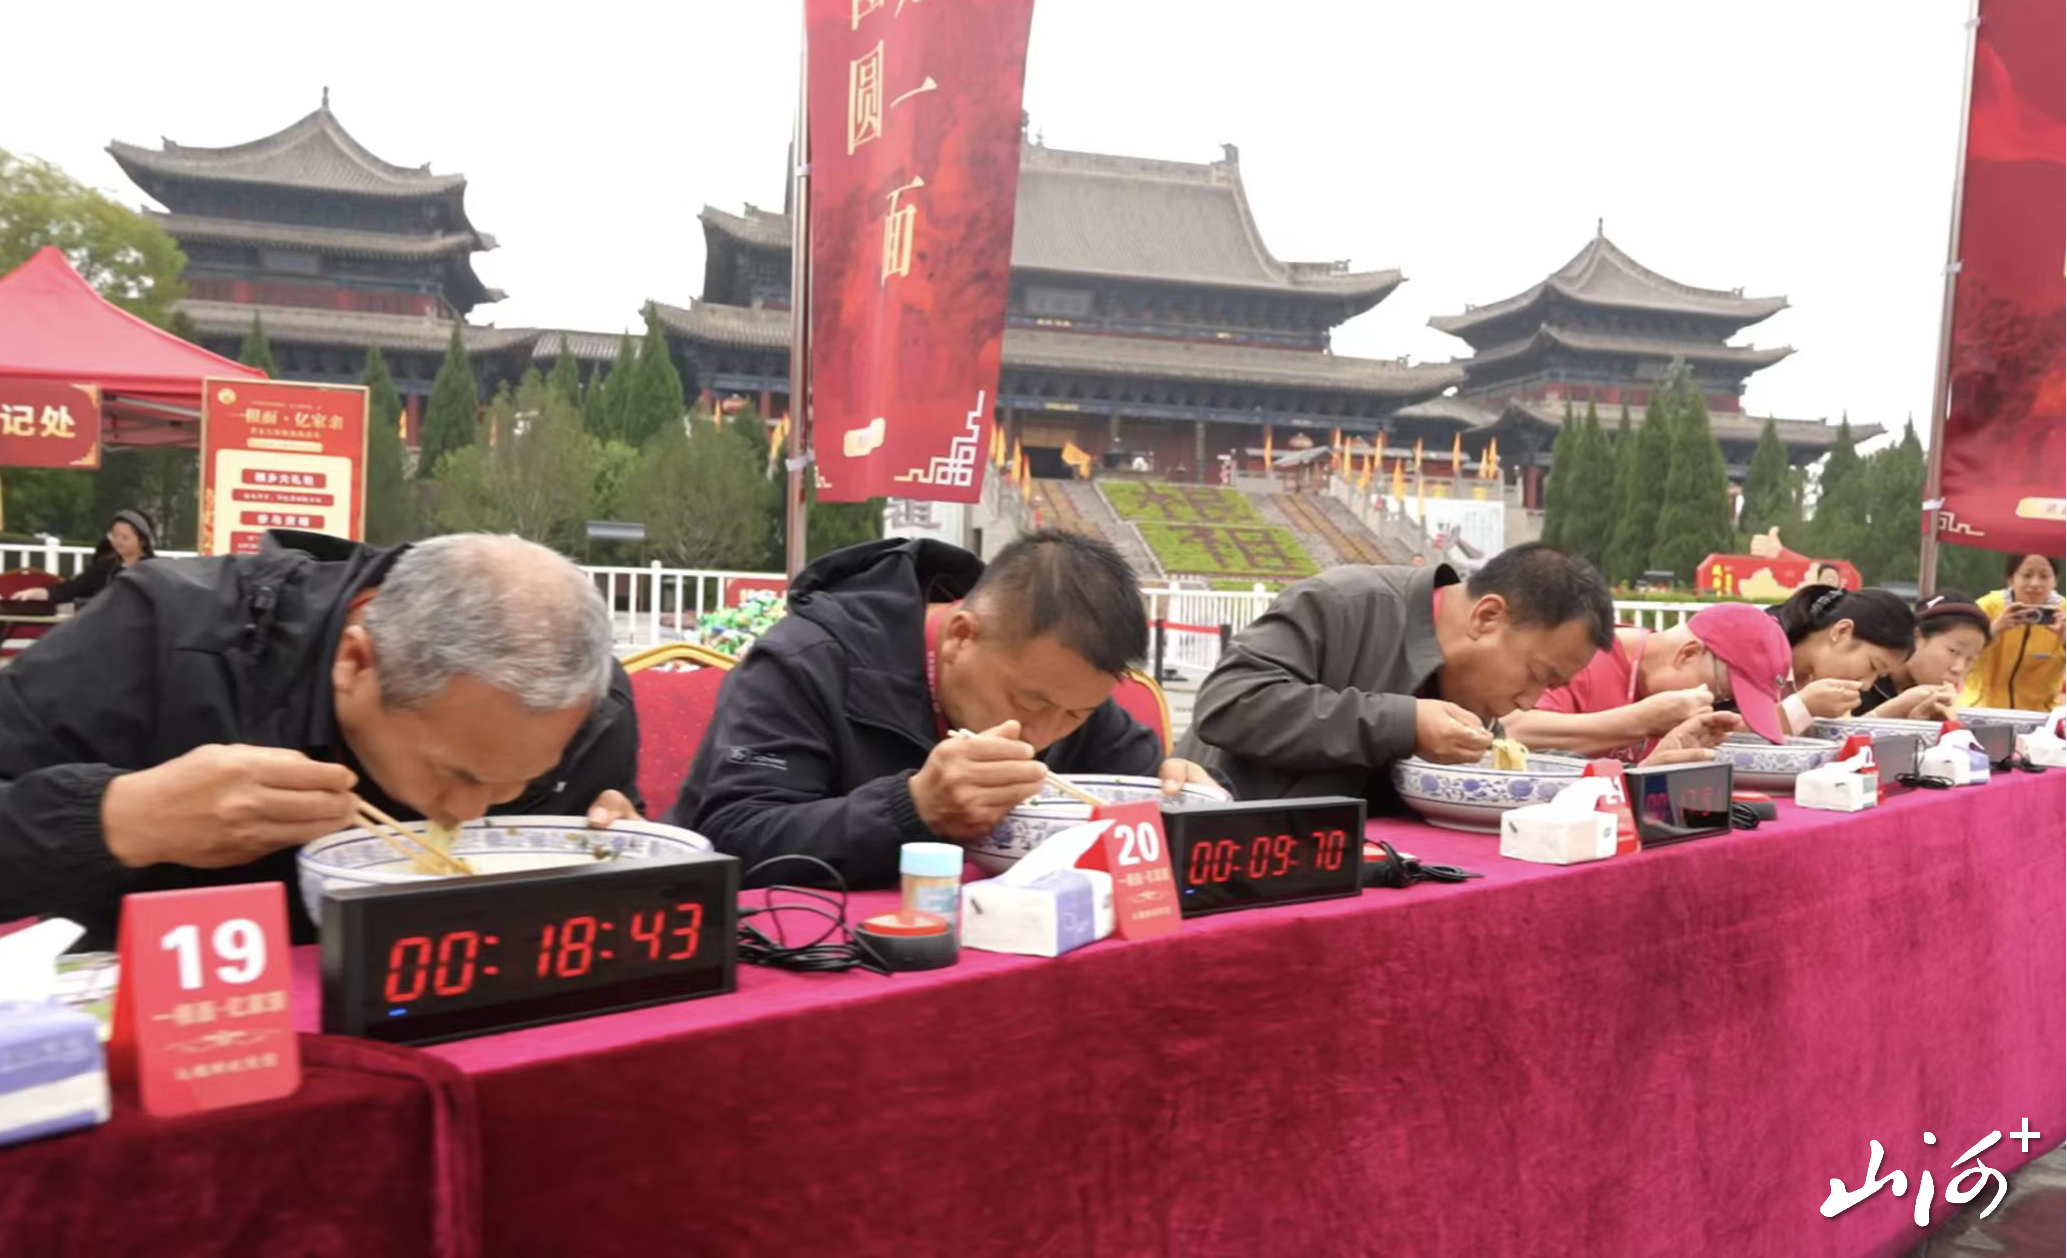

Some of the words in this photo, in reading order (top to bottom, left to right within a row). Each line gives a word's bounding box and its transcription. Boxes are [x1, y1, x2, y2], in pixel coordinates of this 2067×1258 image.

[880, 0, 937, 287] 一面
[0, 404, 76, 438] 记处
[1113, 821, 1160, 867] 20
[1188, 829, 1347, 886] 00:09:70
[160, 918, 268, 990] 19
[384, 902, 704, 1003] 00:18:43
